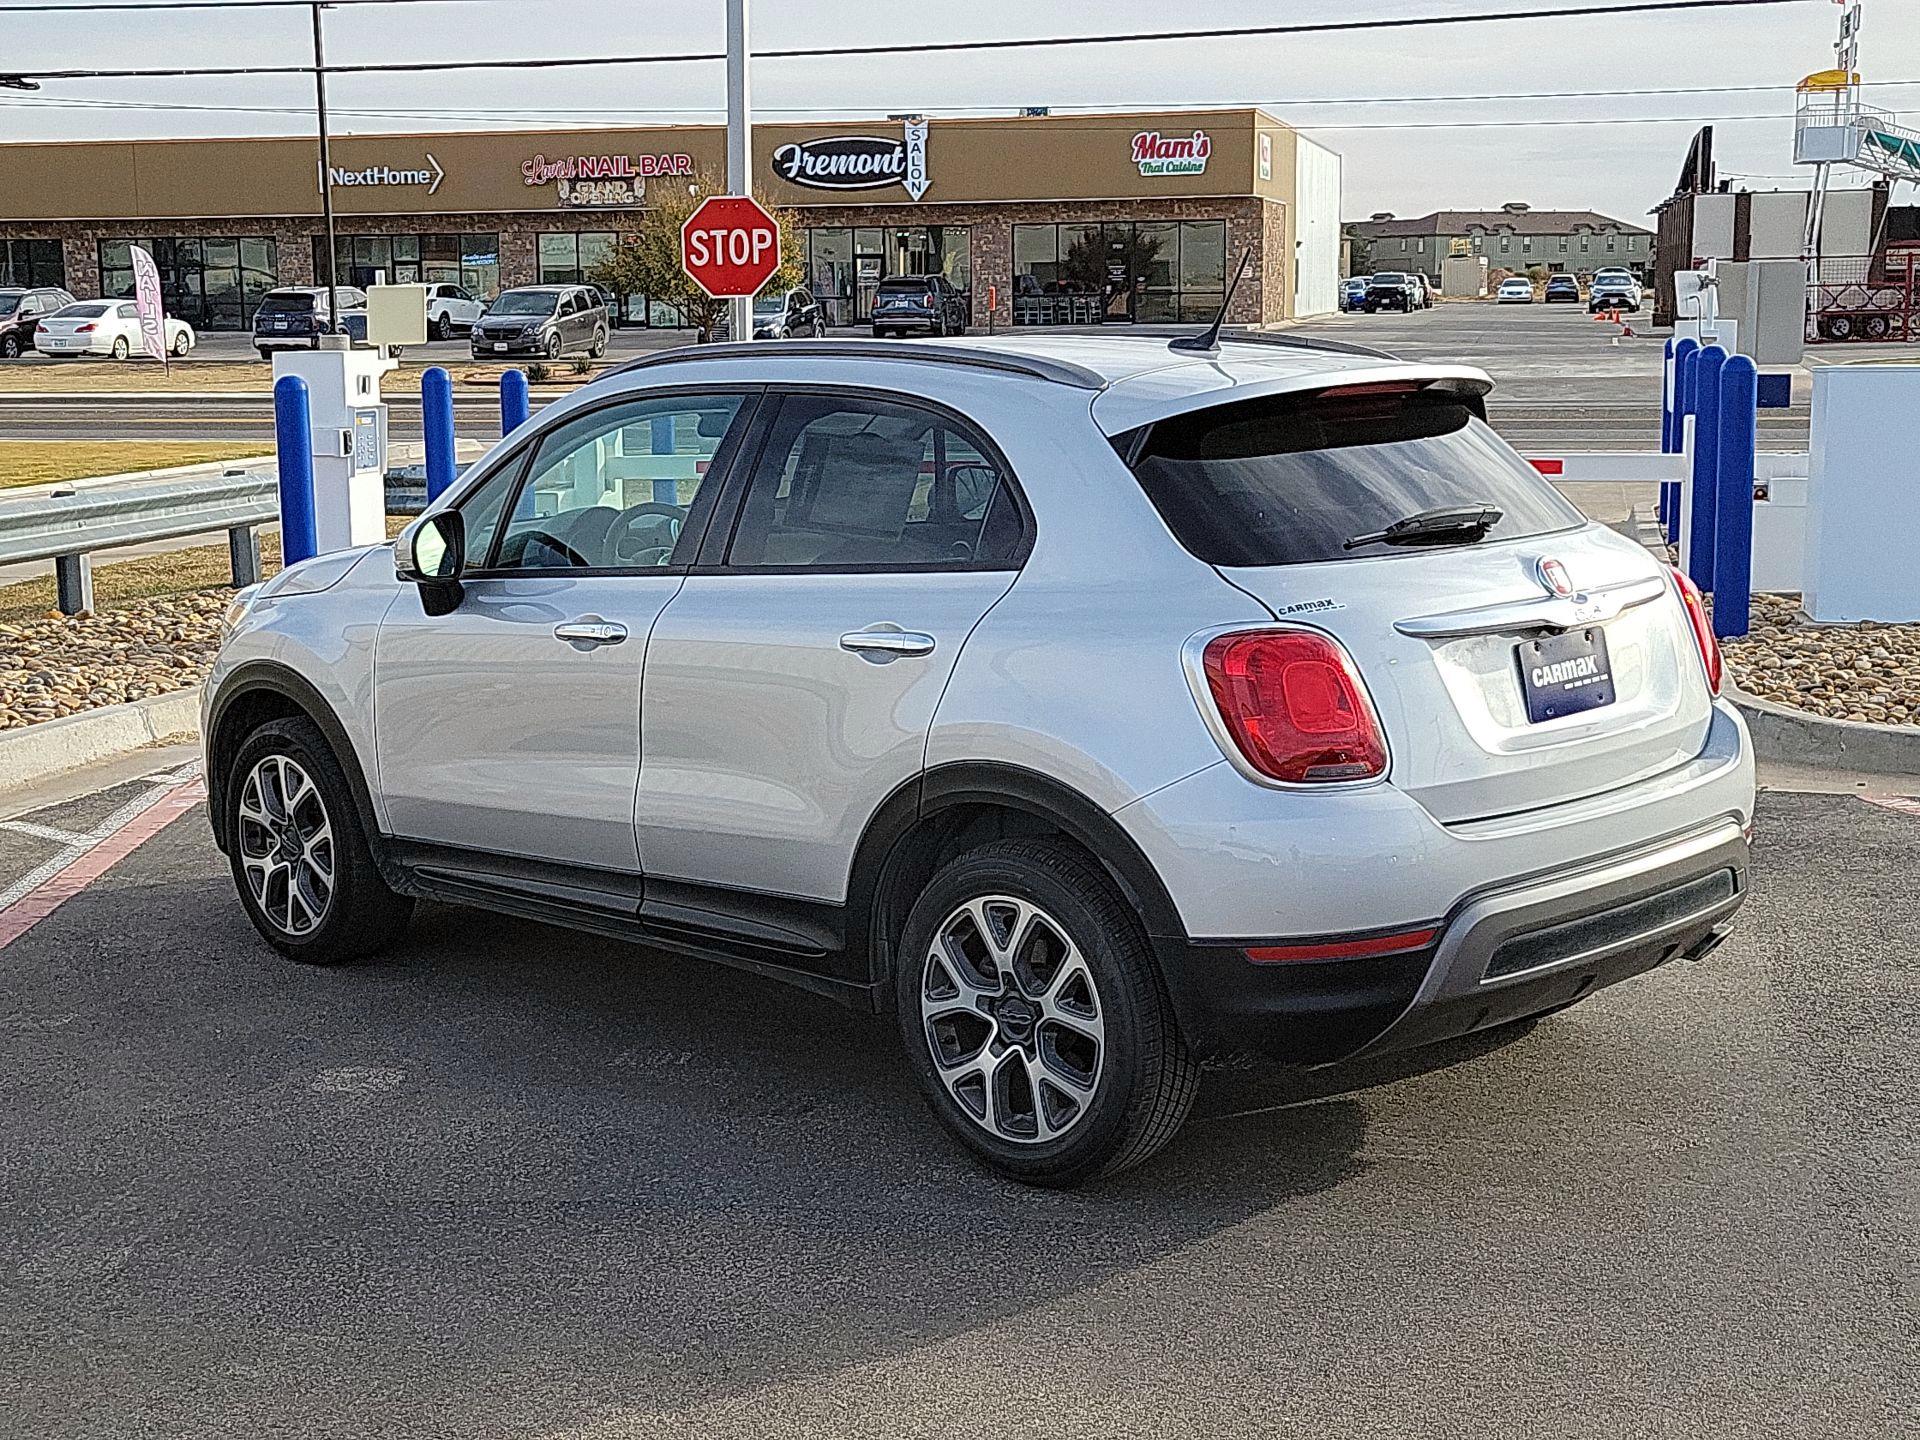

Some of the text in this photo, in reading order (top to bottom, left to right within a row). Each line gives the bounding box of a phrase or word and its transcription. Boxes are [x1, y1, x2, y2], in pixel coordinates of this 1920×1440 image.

[1133, 132, 1209, 160] Mam's
[521, 153, 693, 185] Lavish NAIL BAR
[773, 143, 906, 178] Fremont
[910, 129, 922, 193] SALON
[1140, 160, 1204, 174] Thai Cuisine
[329, 166, 431, 186] NextHome
[575, 181, 627, 193] GRAND
[570, 191, 634, 205] OPENING
[689, 228, 772, 267] STOP
